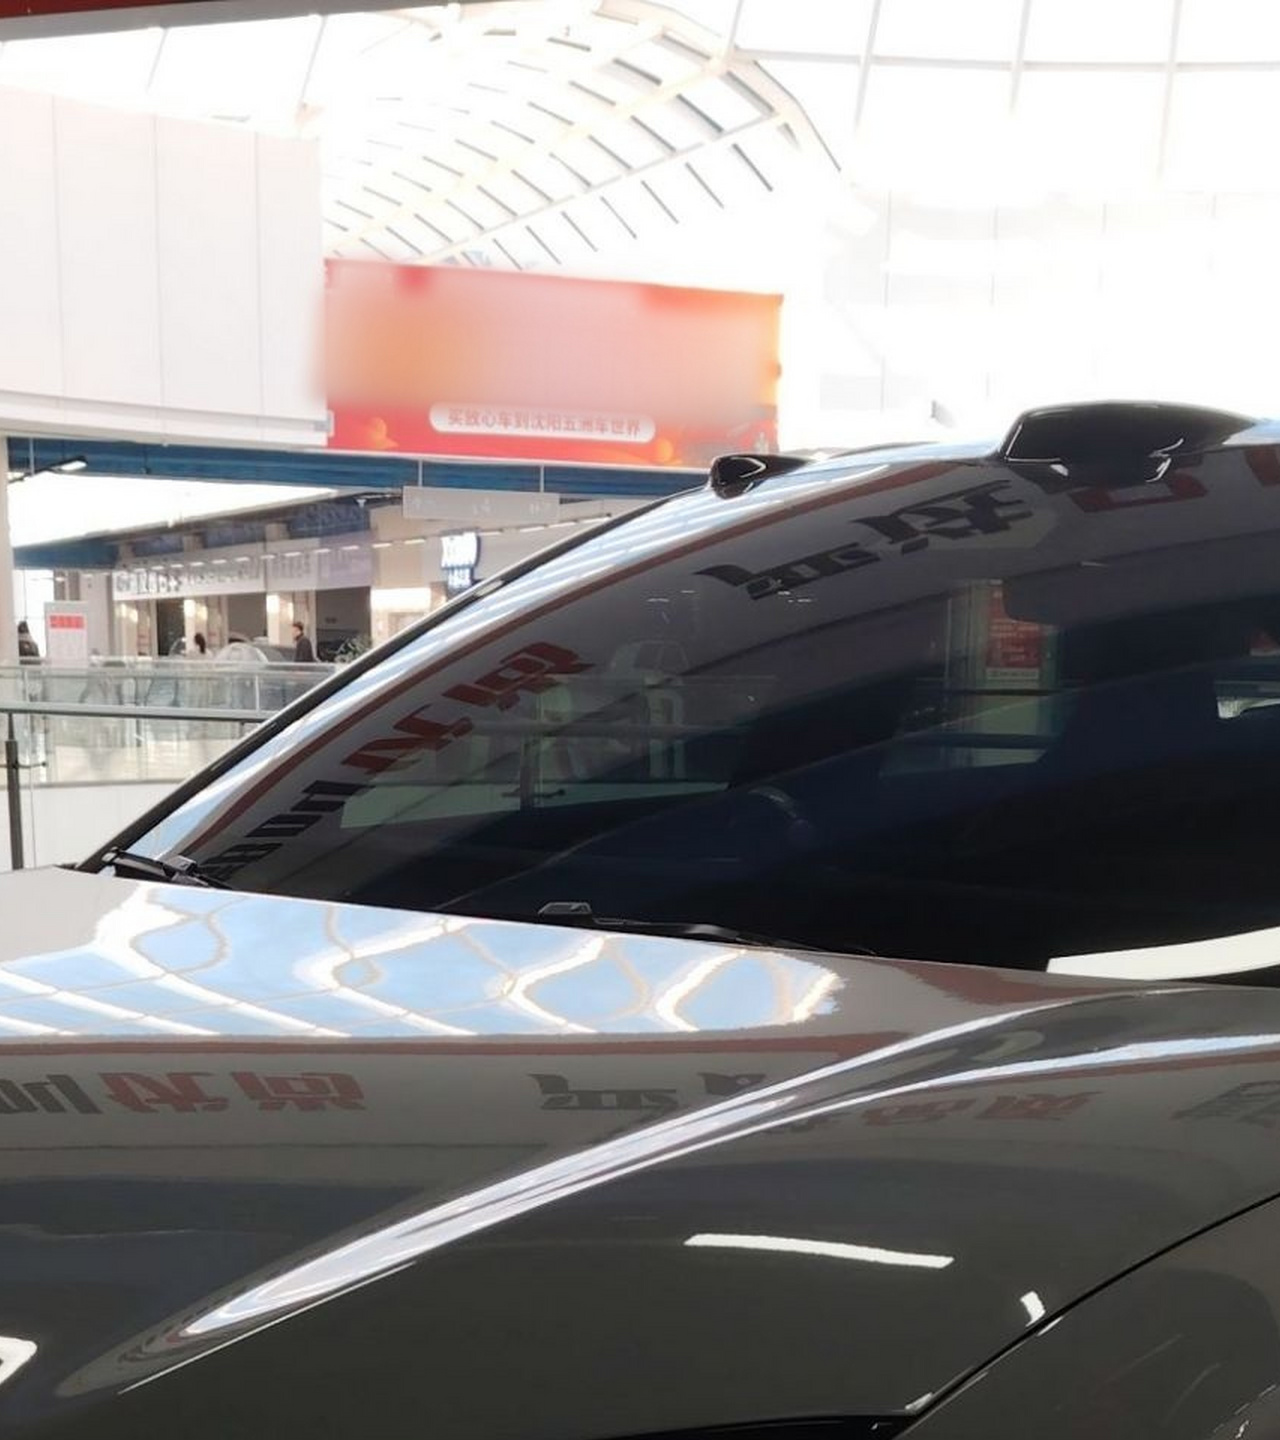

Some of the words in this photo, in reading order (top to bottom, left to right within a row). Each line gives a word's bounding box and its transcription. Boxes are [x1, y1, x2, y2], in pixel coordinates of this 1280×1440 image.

[447, 407, 641, 438] 买放心车到沈阳五洲车世界
